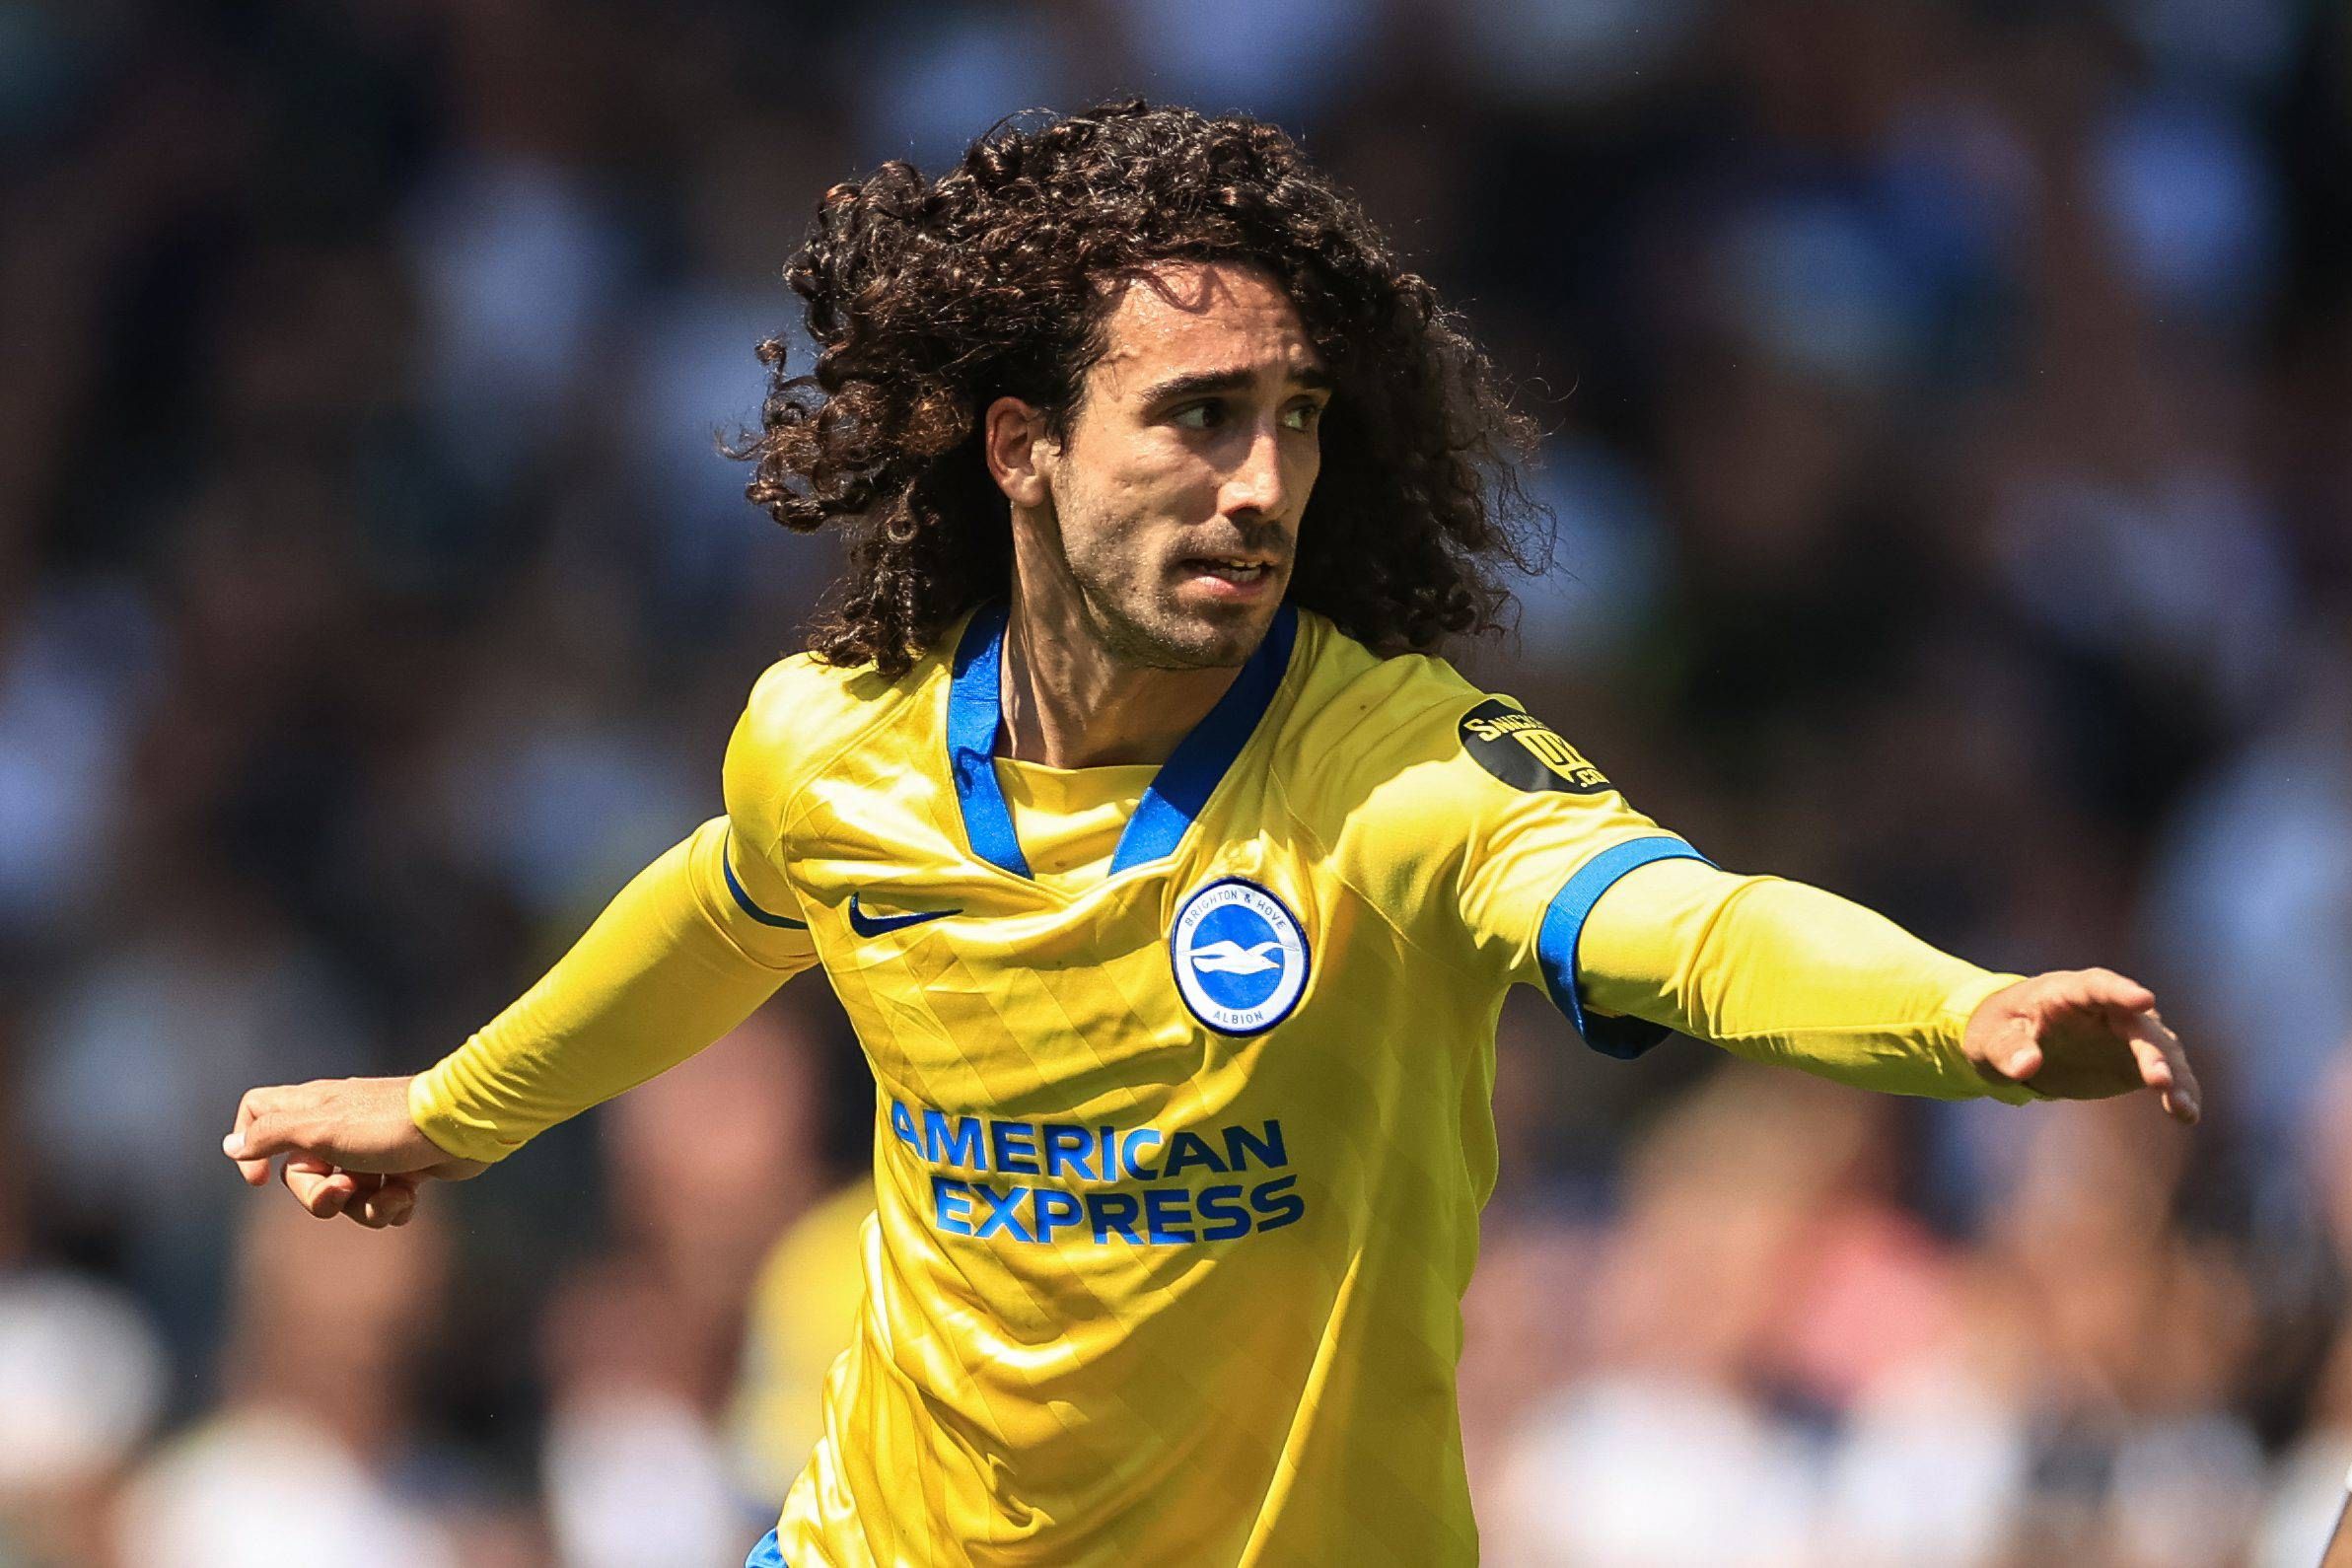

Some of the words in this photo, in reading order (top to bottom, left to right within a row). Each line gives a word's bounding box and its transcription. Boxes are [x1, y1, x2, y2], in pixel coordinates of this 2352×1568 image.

[1184, 890, 1239, 927] BRIGHTON
[1243, 892, 1251, 904] &
[1256, 899, 1287, 929] HOVE
[1213, 1010, 1264, 1025] ALBION
[891, 1099, 1289, 1183] AMERICAN
[931, 1175, 1305, 1246] EXPRESS
